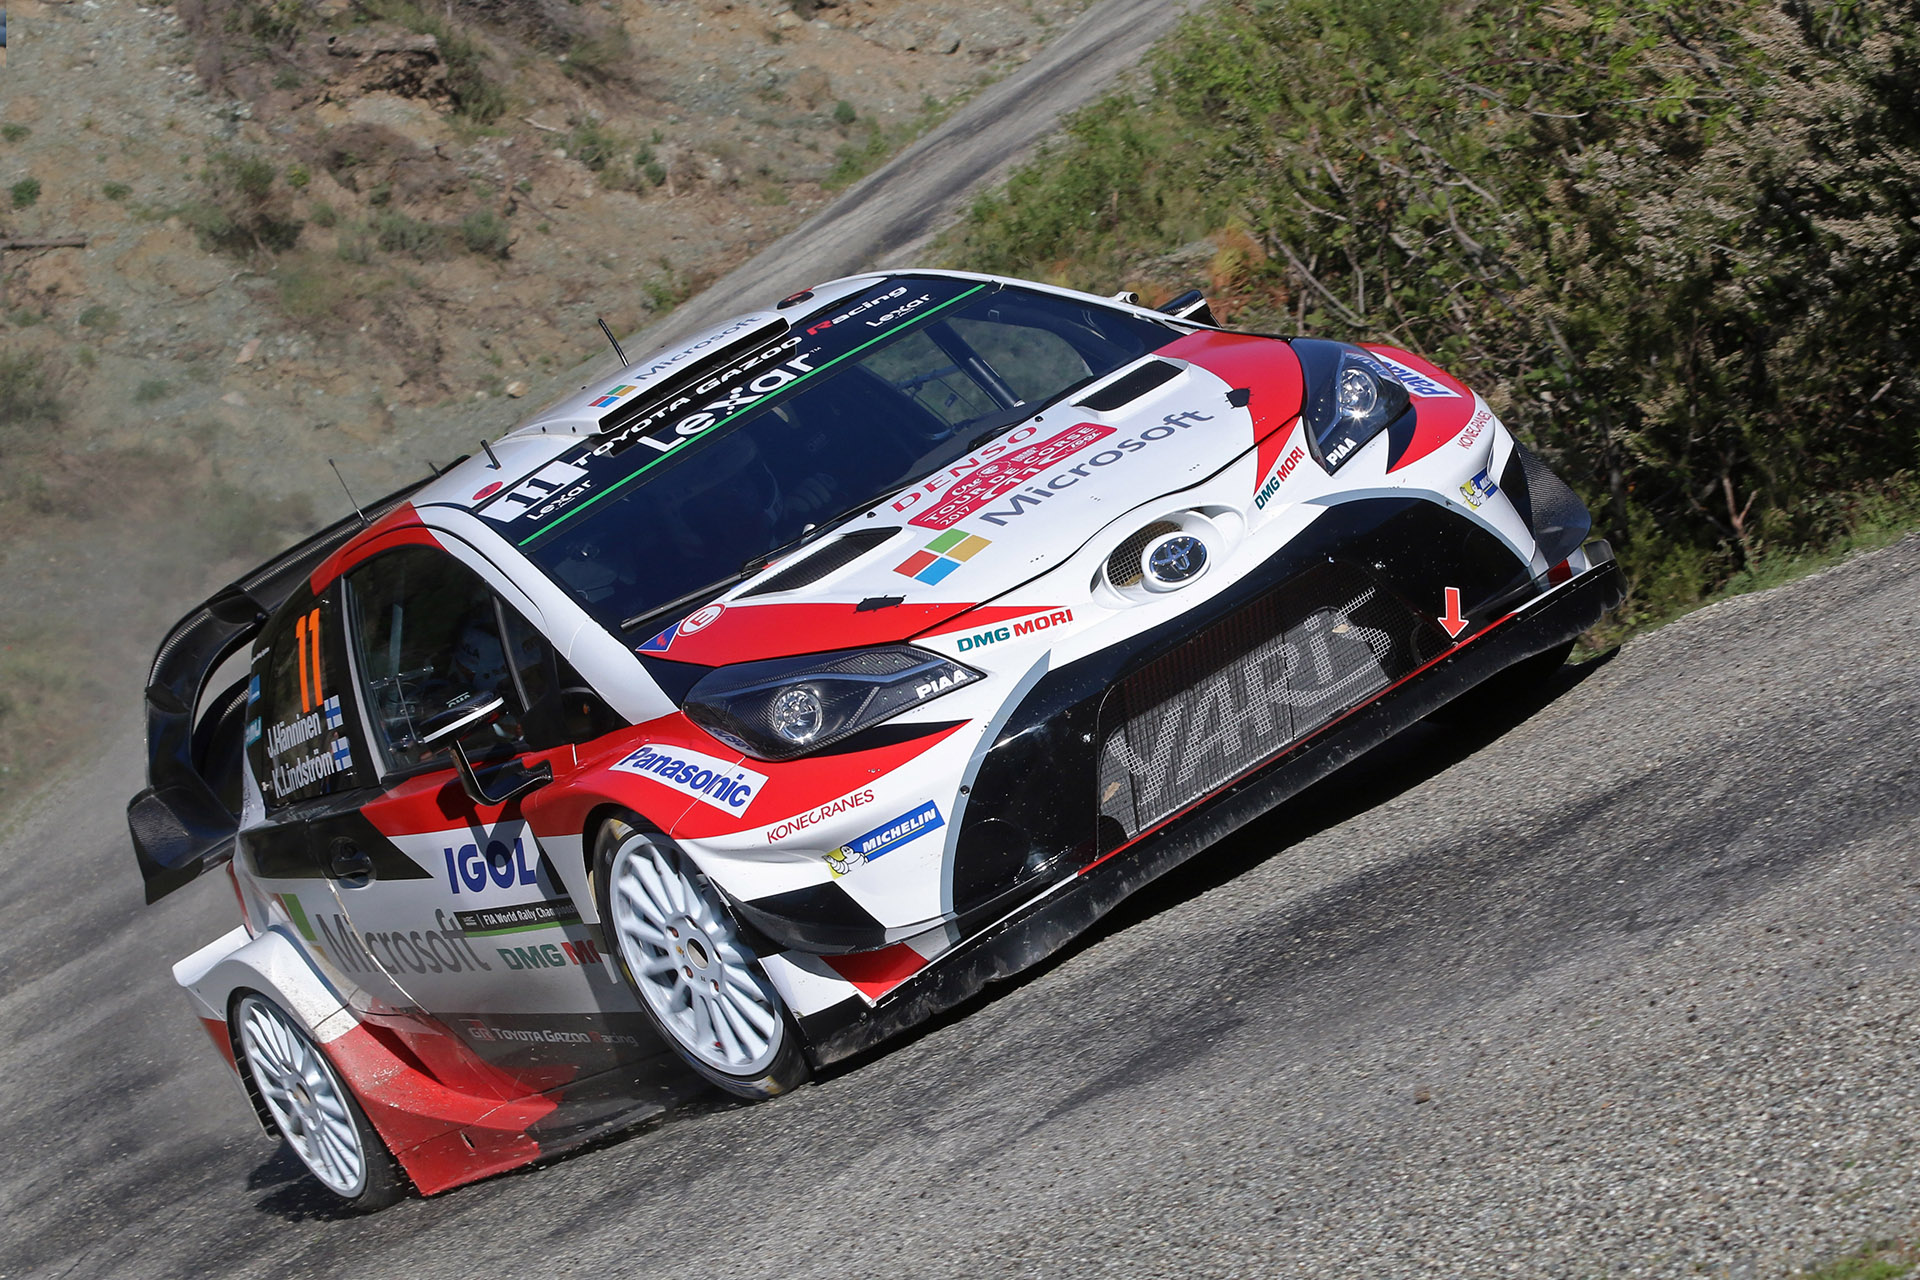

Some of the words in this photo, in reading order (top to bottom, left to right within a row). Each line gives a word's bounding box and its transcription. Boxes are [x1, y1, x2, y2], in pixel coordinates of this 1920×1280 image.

[867, 294, 930, 327] Lexar
[636, 314, 762, 381] Microsoft
[571, 398, 691, 467] TOYOTA
[695, 336, 803, 395] GAZOO
[806, 286, 908, 336] Racing
[637, 351, 815, 452] Lexar
[1325, 437, 1358, 466] PIAA
[1457, 410, 1493, 449] KONECRANES
[505, 478, 565, 508] 11
[892, 426, 1038, 512] DENSO
[923, 487, 988, 522] TOUR
[987, 467, 1021, 486] DE
[1023, 426, 1094, 465] CORSE
[978, 410, 1214, 526] Microsoft
[1254, 476, 1281, 510] DMG
[1276, 446, 1306, 482] MORI
[526, 480, 592, 520] Lexar
[939, 505, 970, 525] 2017
[956, 626, 1011, 652] DMG
[1012, 608, 1074, 637] MORI
[295, 608, 324, 713] 11
[915, 669, 968, 700] PIAA
[1107, 586, 1392, 808] YARIS
[266, 711, 322, 759] J.Hänninen
[271, 748, 336, 799] K.Lindström
[622, 747, 752, 808] Panasonic
[766, 789, 875, 844] KONECRANES
[861, 807, 937, 854] MICHELIN
[443, 837, 537, 894] IGOL
[315, 907, 493, 975] Microsoft
[482, 912, 498, 926] FIA
[493, 910, 519, 924] World
[516, 907, 538, 921] Rally
[495, 943, 566, 971] DMG
[492, 1027, 545, 1043] TOYOTA
[544, 1029, 591, 1044] GAZOO
[588, 1030, 640, 1047] Racing
